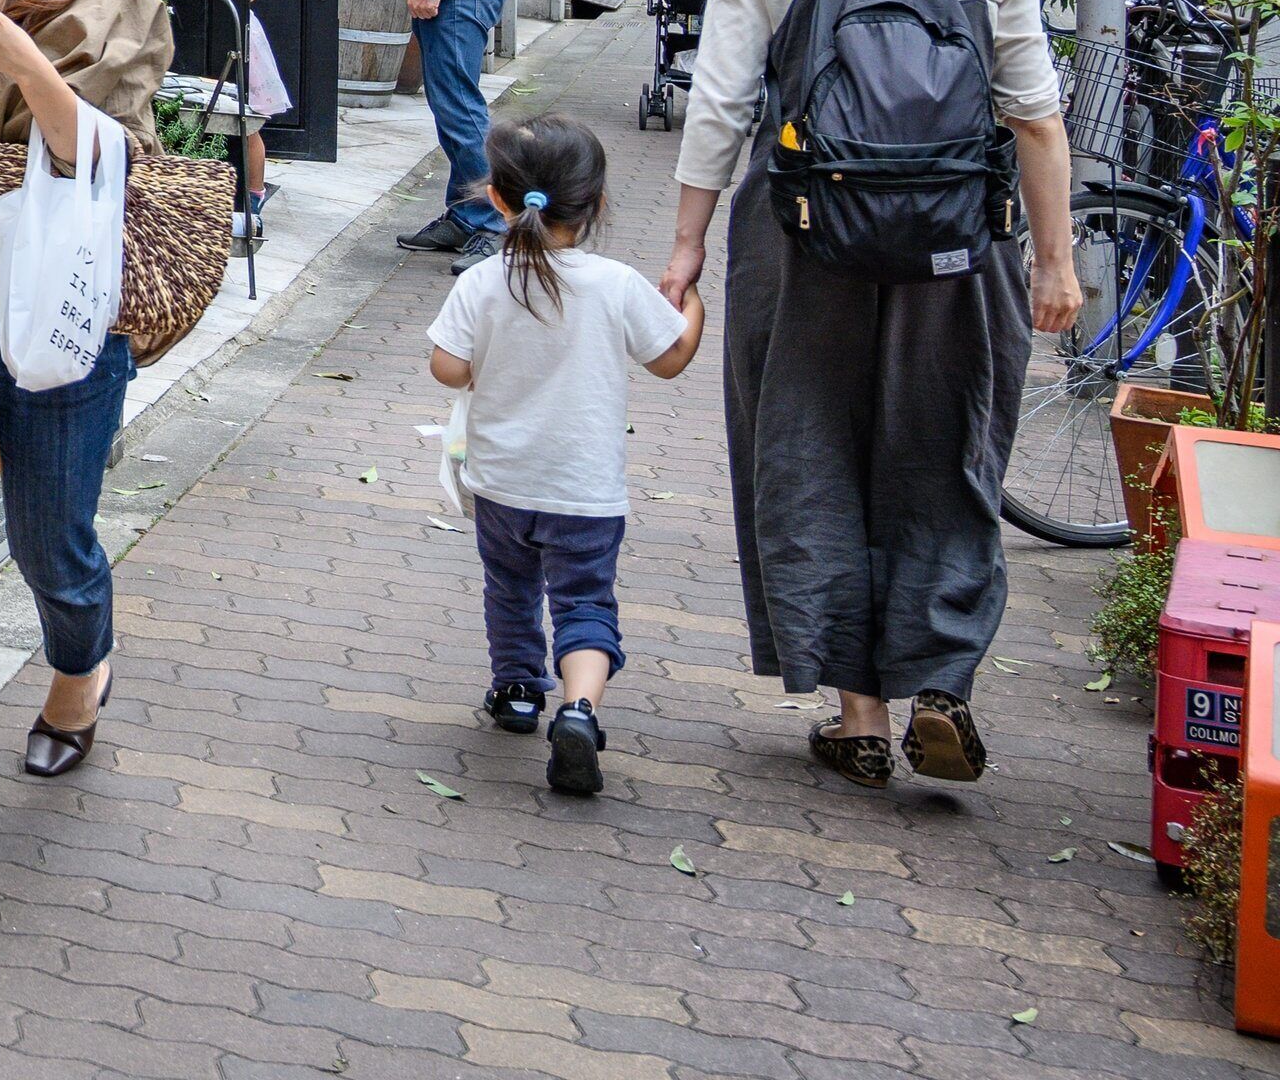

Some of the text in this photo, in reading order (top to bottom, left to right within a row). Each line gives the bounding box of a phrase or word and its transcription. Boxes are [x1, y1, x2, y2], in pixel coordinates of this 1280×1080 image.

[60, 300, 93, 334] BREA
[1193, 692, 1243, 717] 9 N
[1189, 726, 1241, 744] COLLMO
